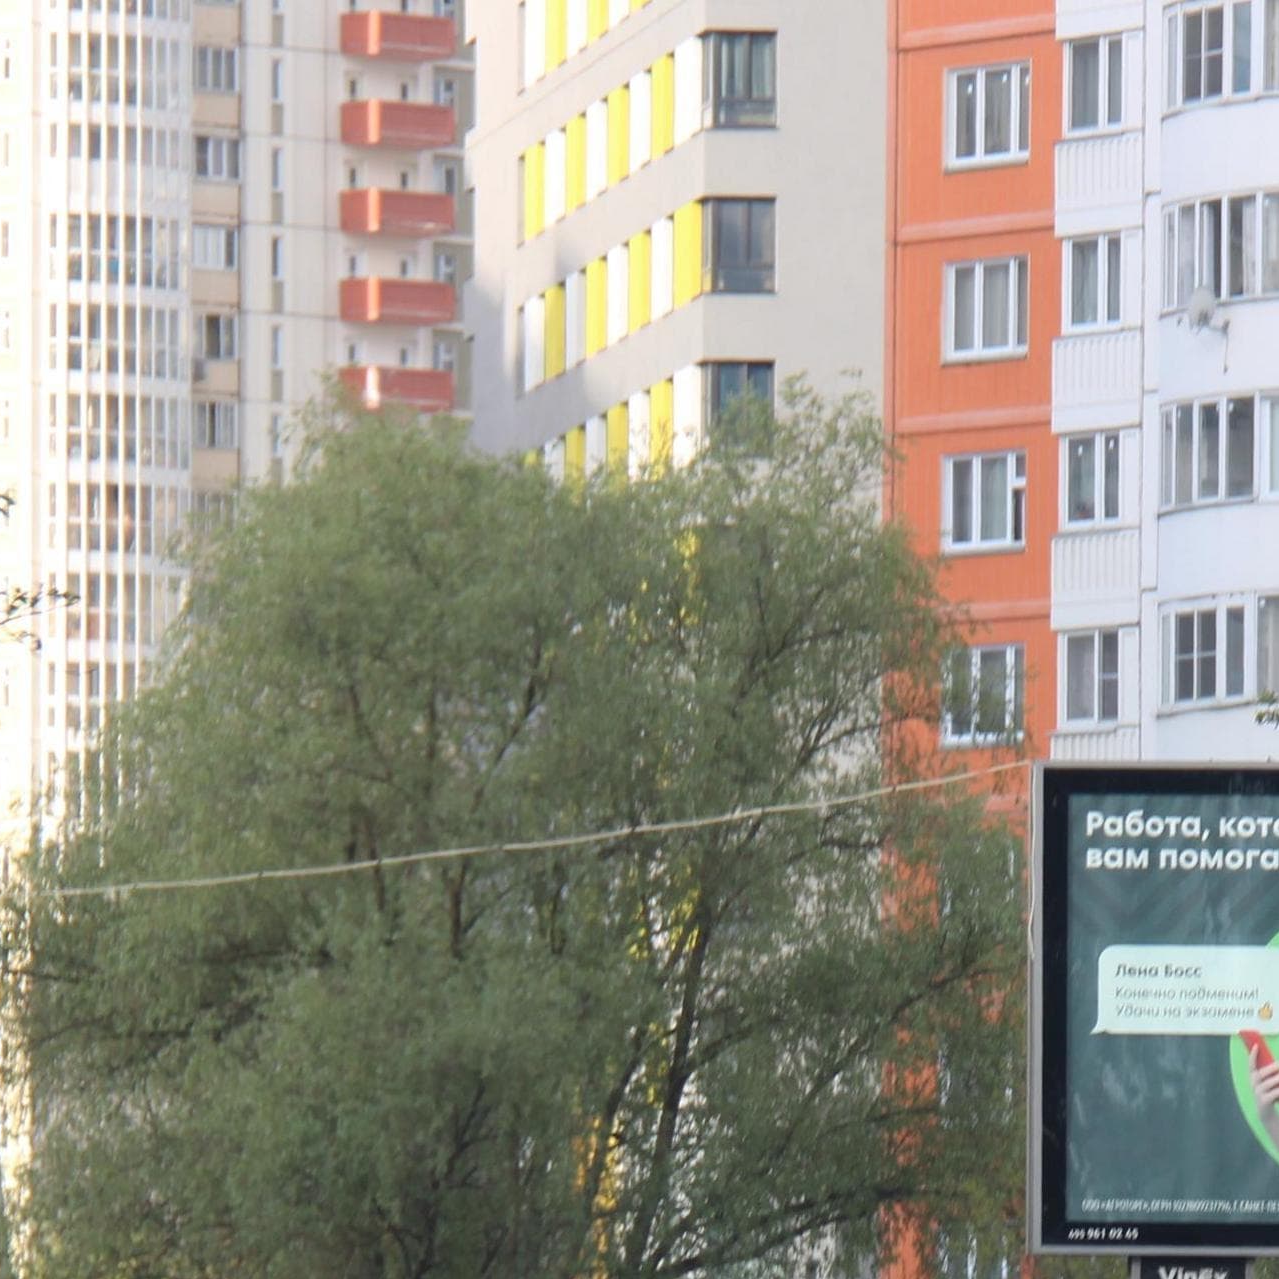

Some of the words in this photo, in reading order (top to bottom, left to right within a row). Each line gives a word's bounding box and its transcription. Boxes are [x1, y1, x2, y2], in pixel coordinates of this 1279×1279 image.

[1086, 810, 1210, 842] Работа,
[1086, 848, 1149, 870] вам
[1115, 964, 1159, 978] Лена
[1164, 964, 1203, 978] Босс
[1115, 986, 1176, 1000] Конечно
[1116, 1003, 1160, 1018] Удачи
[1163, 1005, 1181, 1017] на
[1186, 1005, 1254, 1018] экзамене
